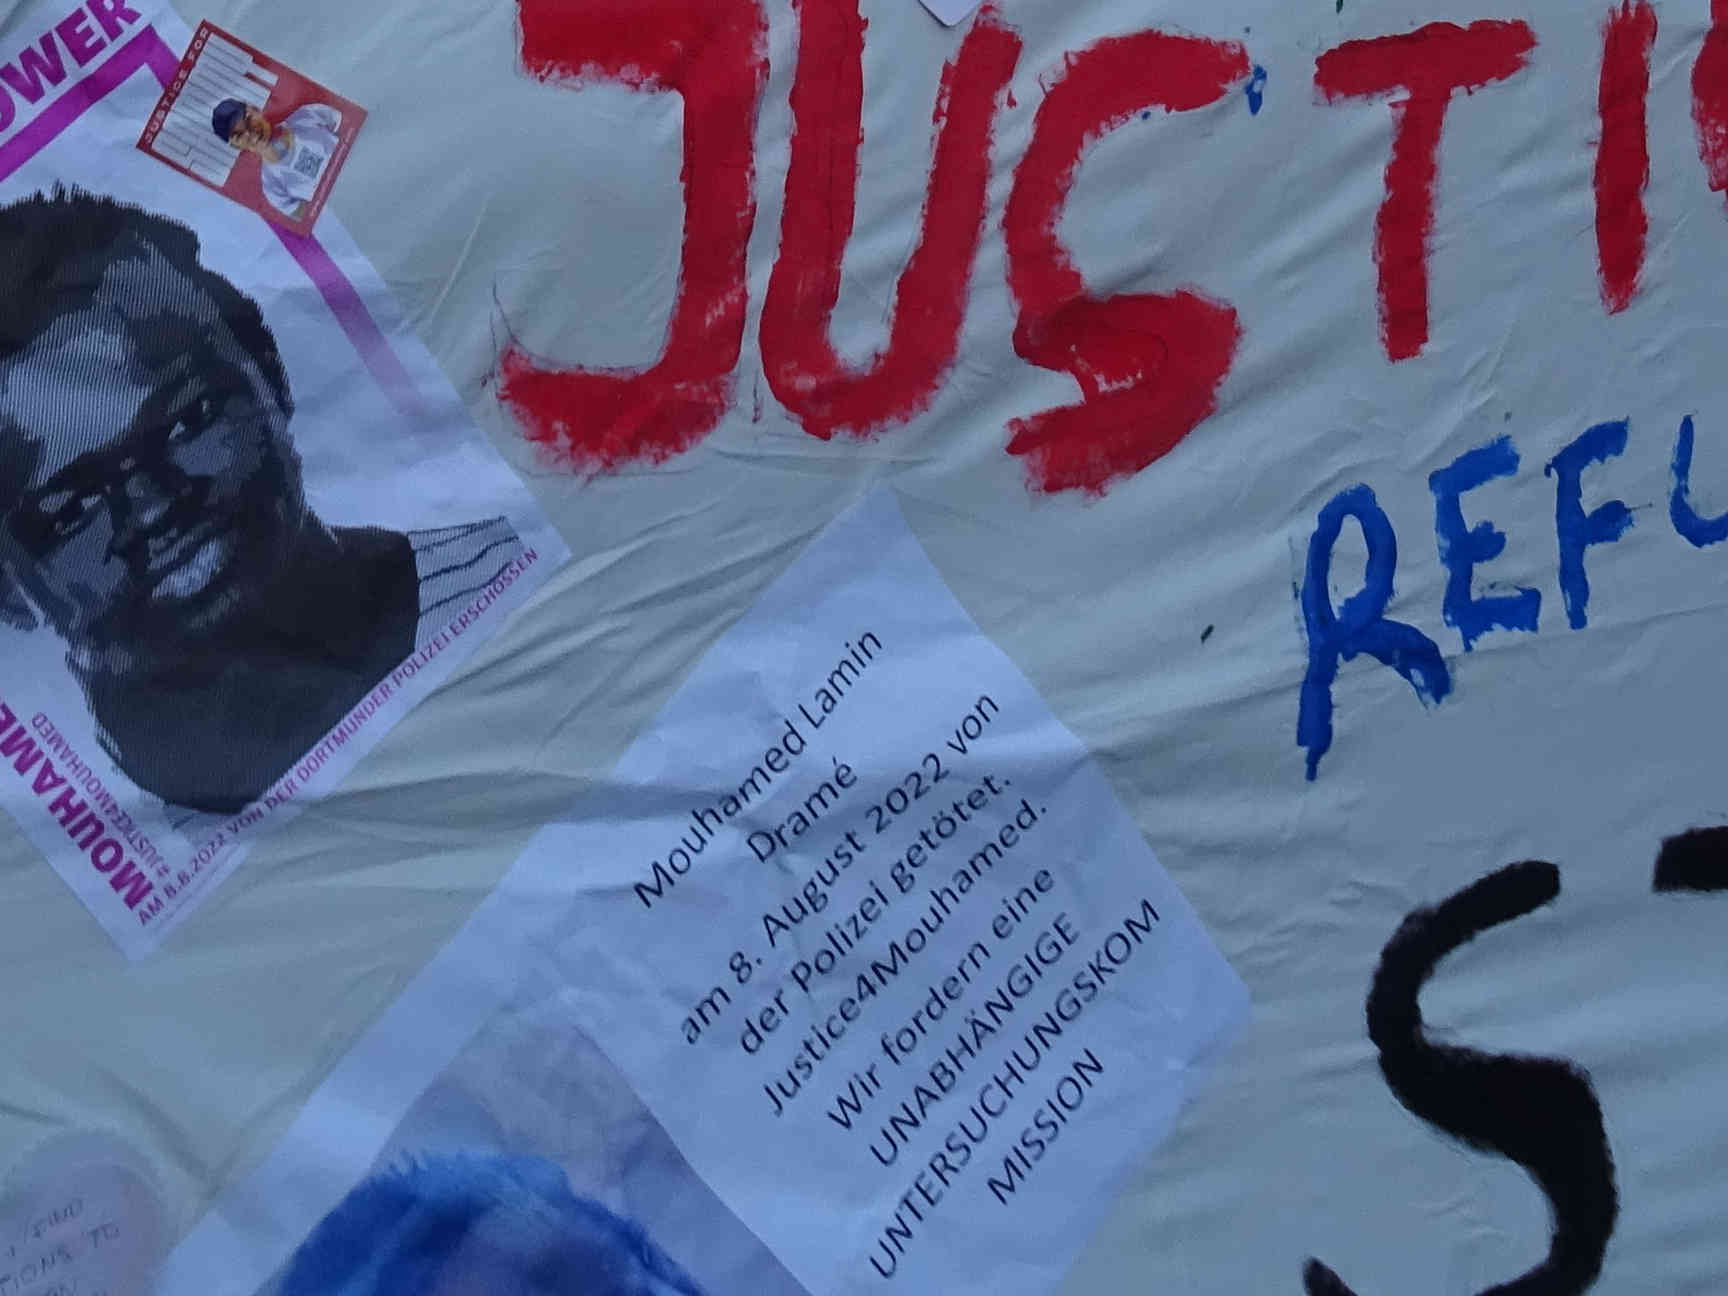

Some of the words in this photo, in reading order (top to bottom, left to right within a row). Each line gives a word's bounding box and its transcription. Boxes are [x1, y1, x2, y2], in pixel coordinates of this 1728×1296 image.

[144, 68, 189, 145] JUSTICE
[137, 895, 166, 926] AM
[227, 806, 265, 835] VON
[266, 779, 299, 810] DER
[297, 683, 393, 782] DORTMUNDER
[391, 630, 452, 689] POLIZEI
[450, 547, 539, 637] ERSCHOSSEN
[633, 719, 808, 909] Mouhamed
[803, 631, 883, 729] Lamin
[679, 994, 732, 1045] am
[728, 950, 764, 985] 8.
[763, 831, 867, 947] August
[864, 752, 951, 835] 2022
[946, 693, 1001, 757] von
[746, 758, 860, 864] Dramé
[739, 1001, 792, 1056] der
[791, 886, 887, 993] Polizei
[890, 777, 1013, 895] getötet.
[770, 806, 1048, 1118] Justice4Mouhamed.
[827, 1064, 880, 1133] Wir
[880, 950, 994, 1067] fordern
[991, 867, 1056, 941] eine
[870, 912, 1081, 1169] UNABHÄNGIGE
[870, 899, 1161, 1281] UNTERSUCHUNGSKOM
[987, 1047, 1106, 1205] MISSION
